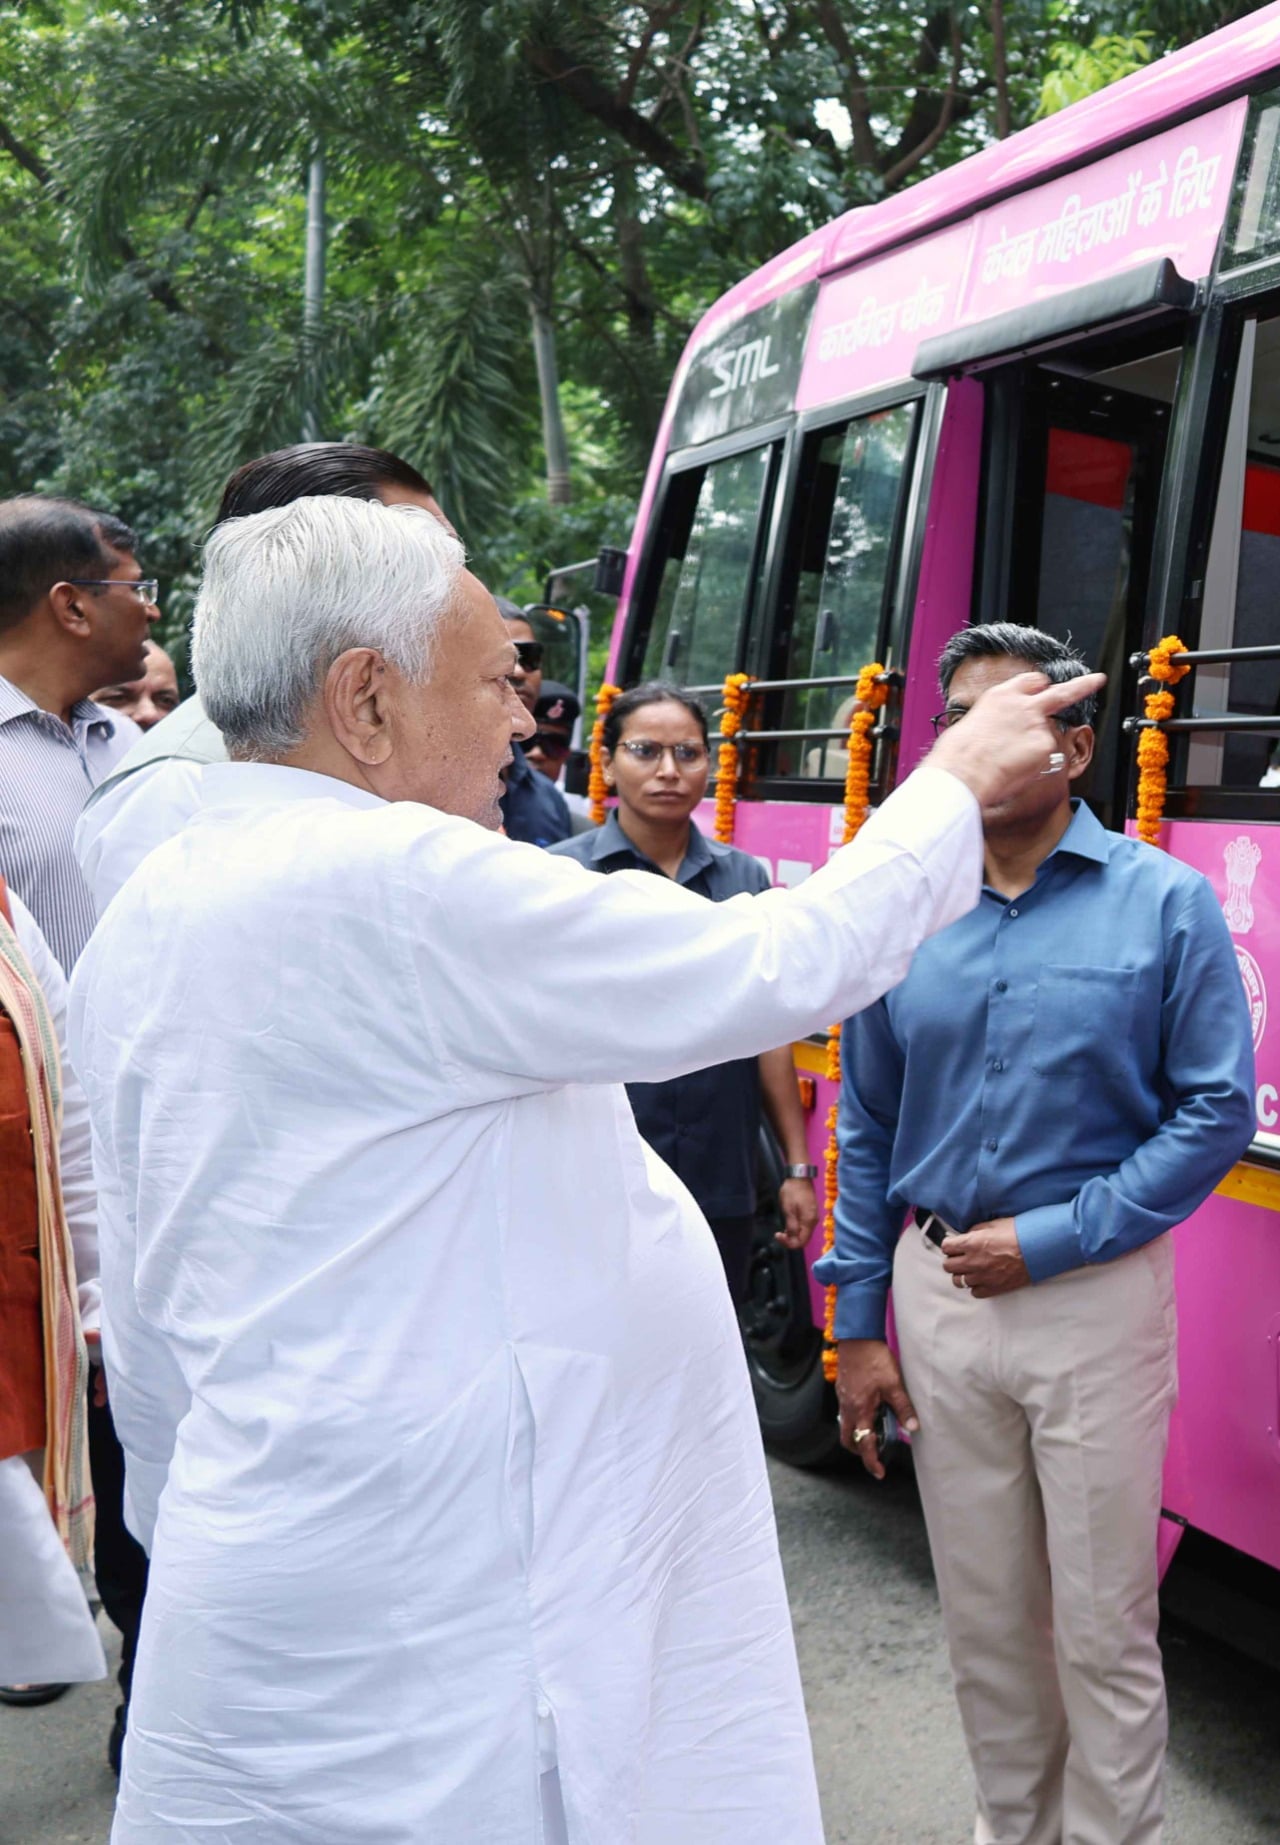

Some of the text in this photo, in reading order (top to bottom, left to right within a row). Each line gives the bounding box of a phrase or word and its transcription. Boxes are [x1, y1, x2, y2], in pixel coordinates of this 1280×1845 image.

[981, 145, 1222, 285] केवल महिलाओं के लिए
[709, 335, 780, 398] SML
